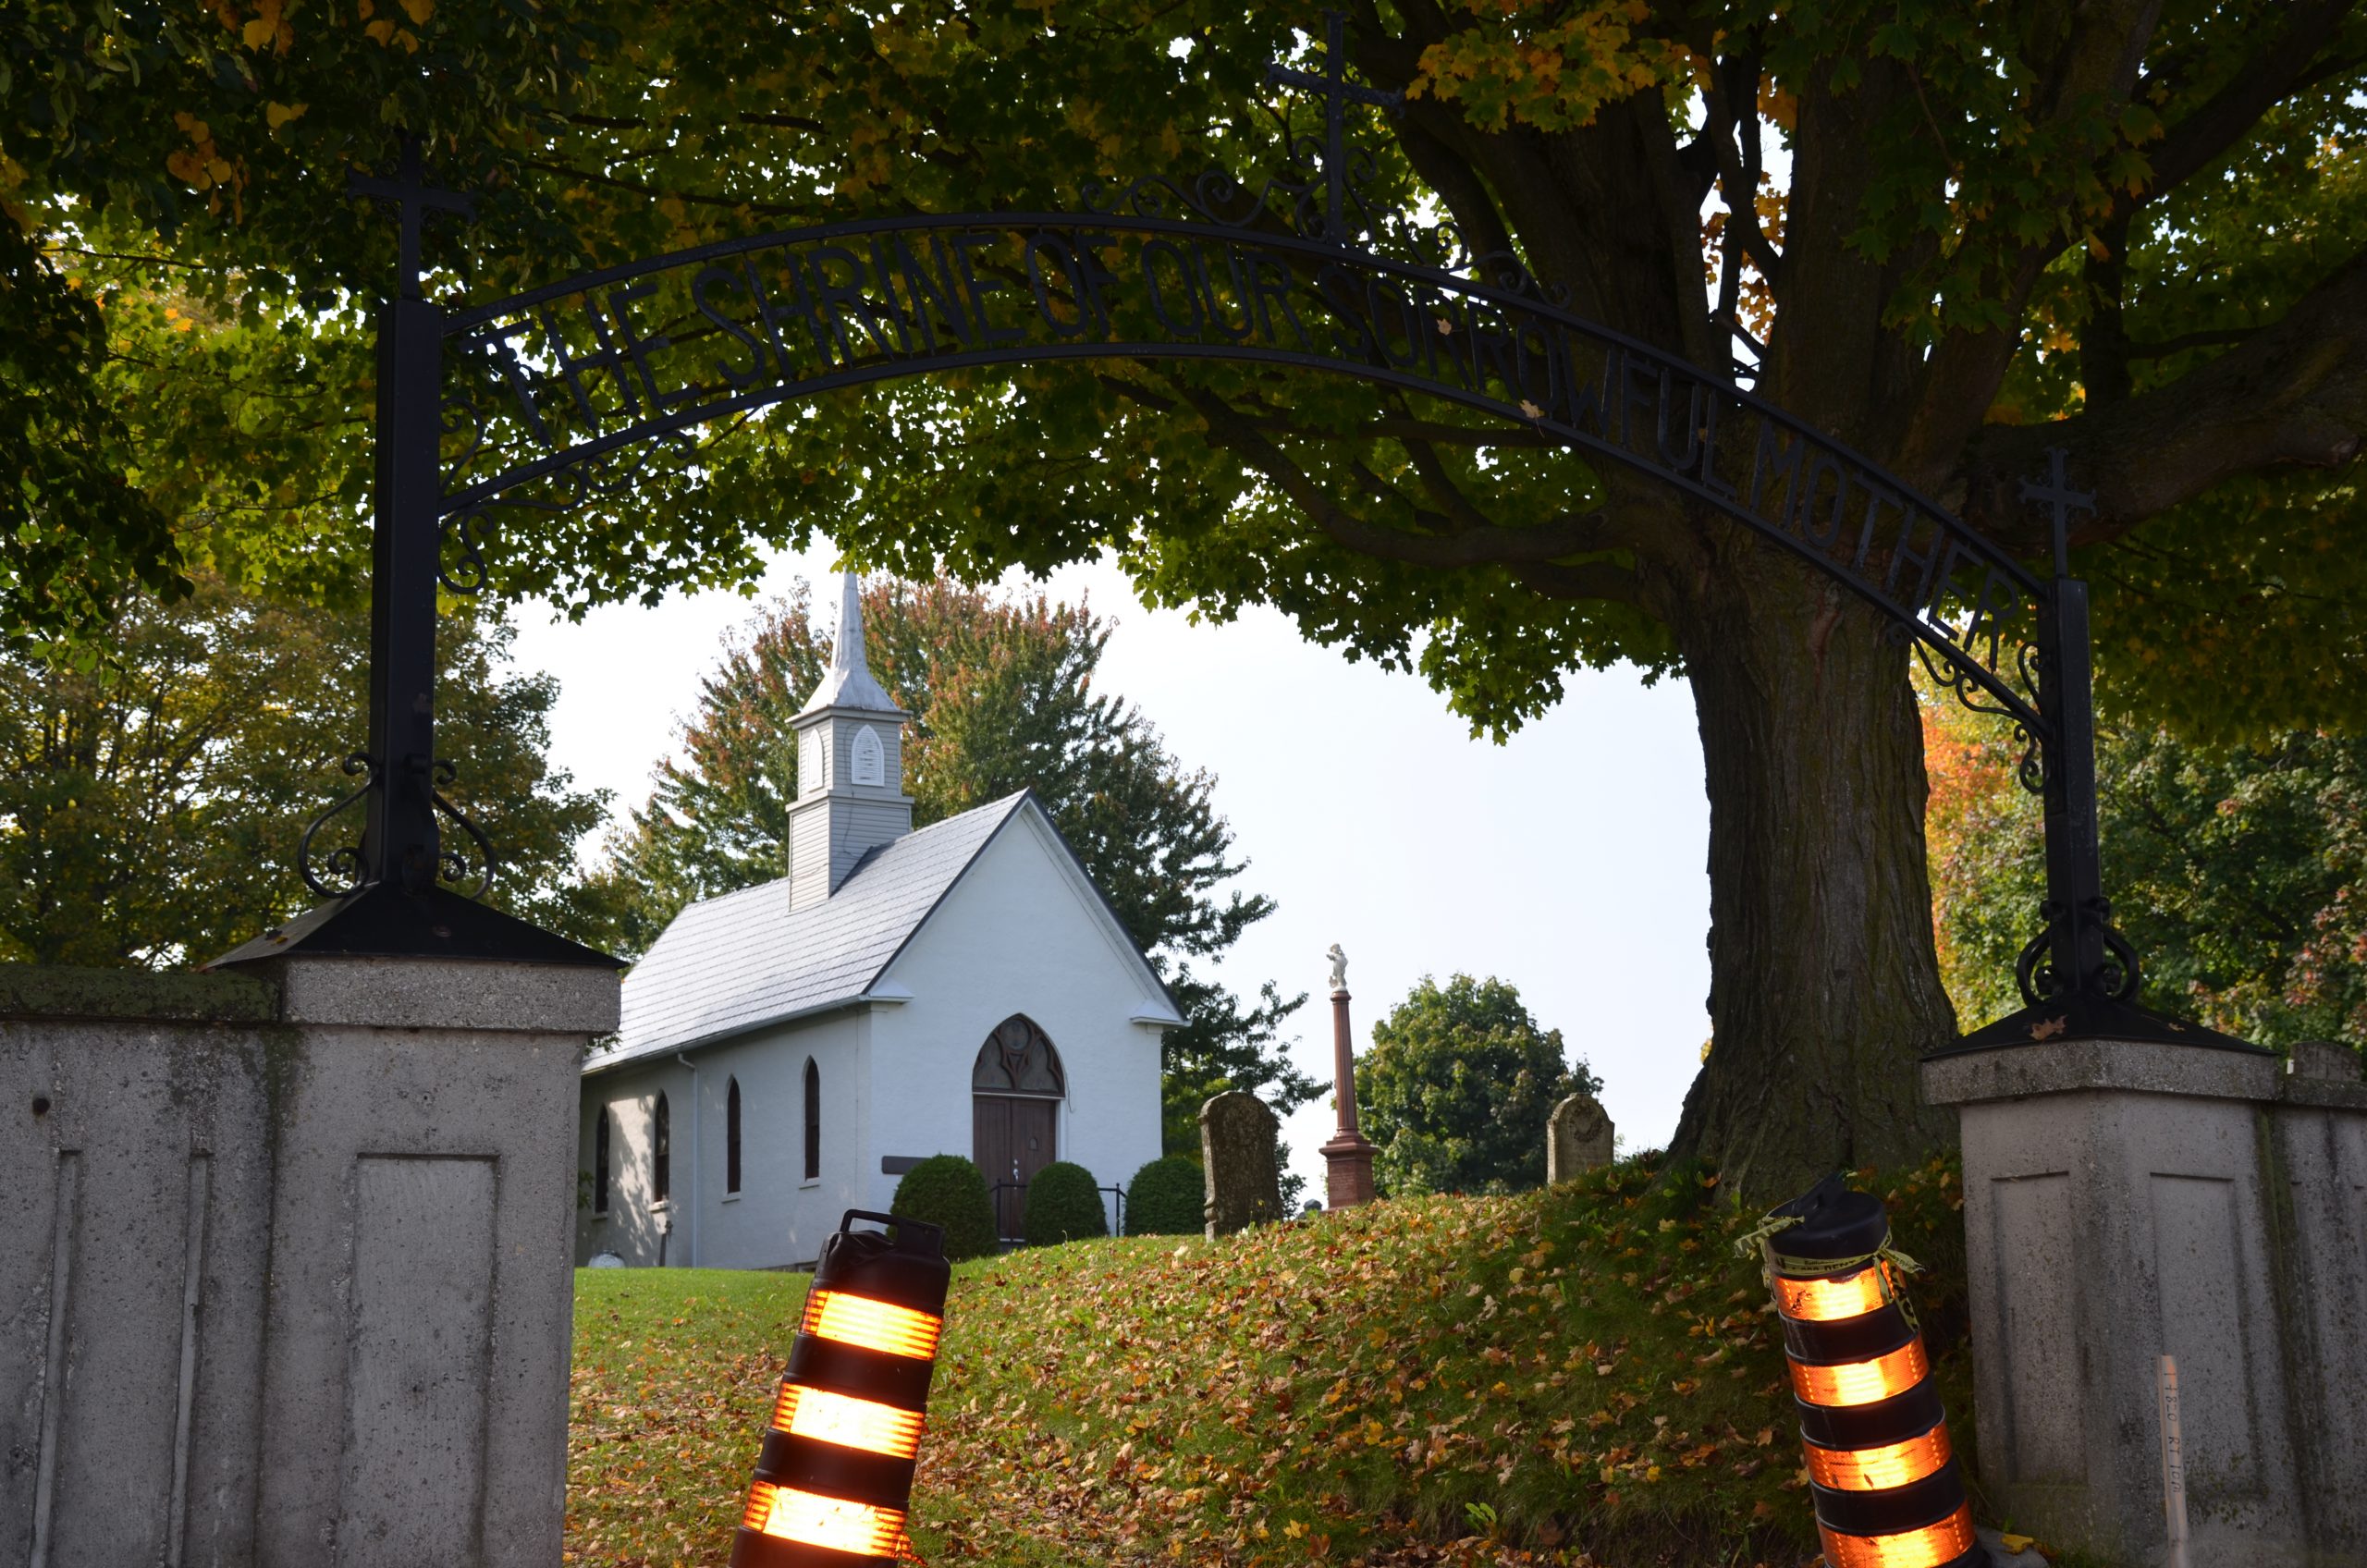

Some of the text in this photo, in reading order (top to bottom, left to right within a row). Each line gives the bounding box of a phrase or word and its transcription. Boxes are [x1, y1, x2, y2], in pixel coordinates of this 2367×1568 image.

[462, 232, 2018, 669] THE SHRINE OF OUR SORROWFUL MOTHER
